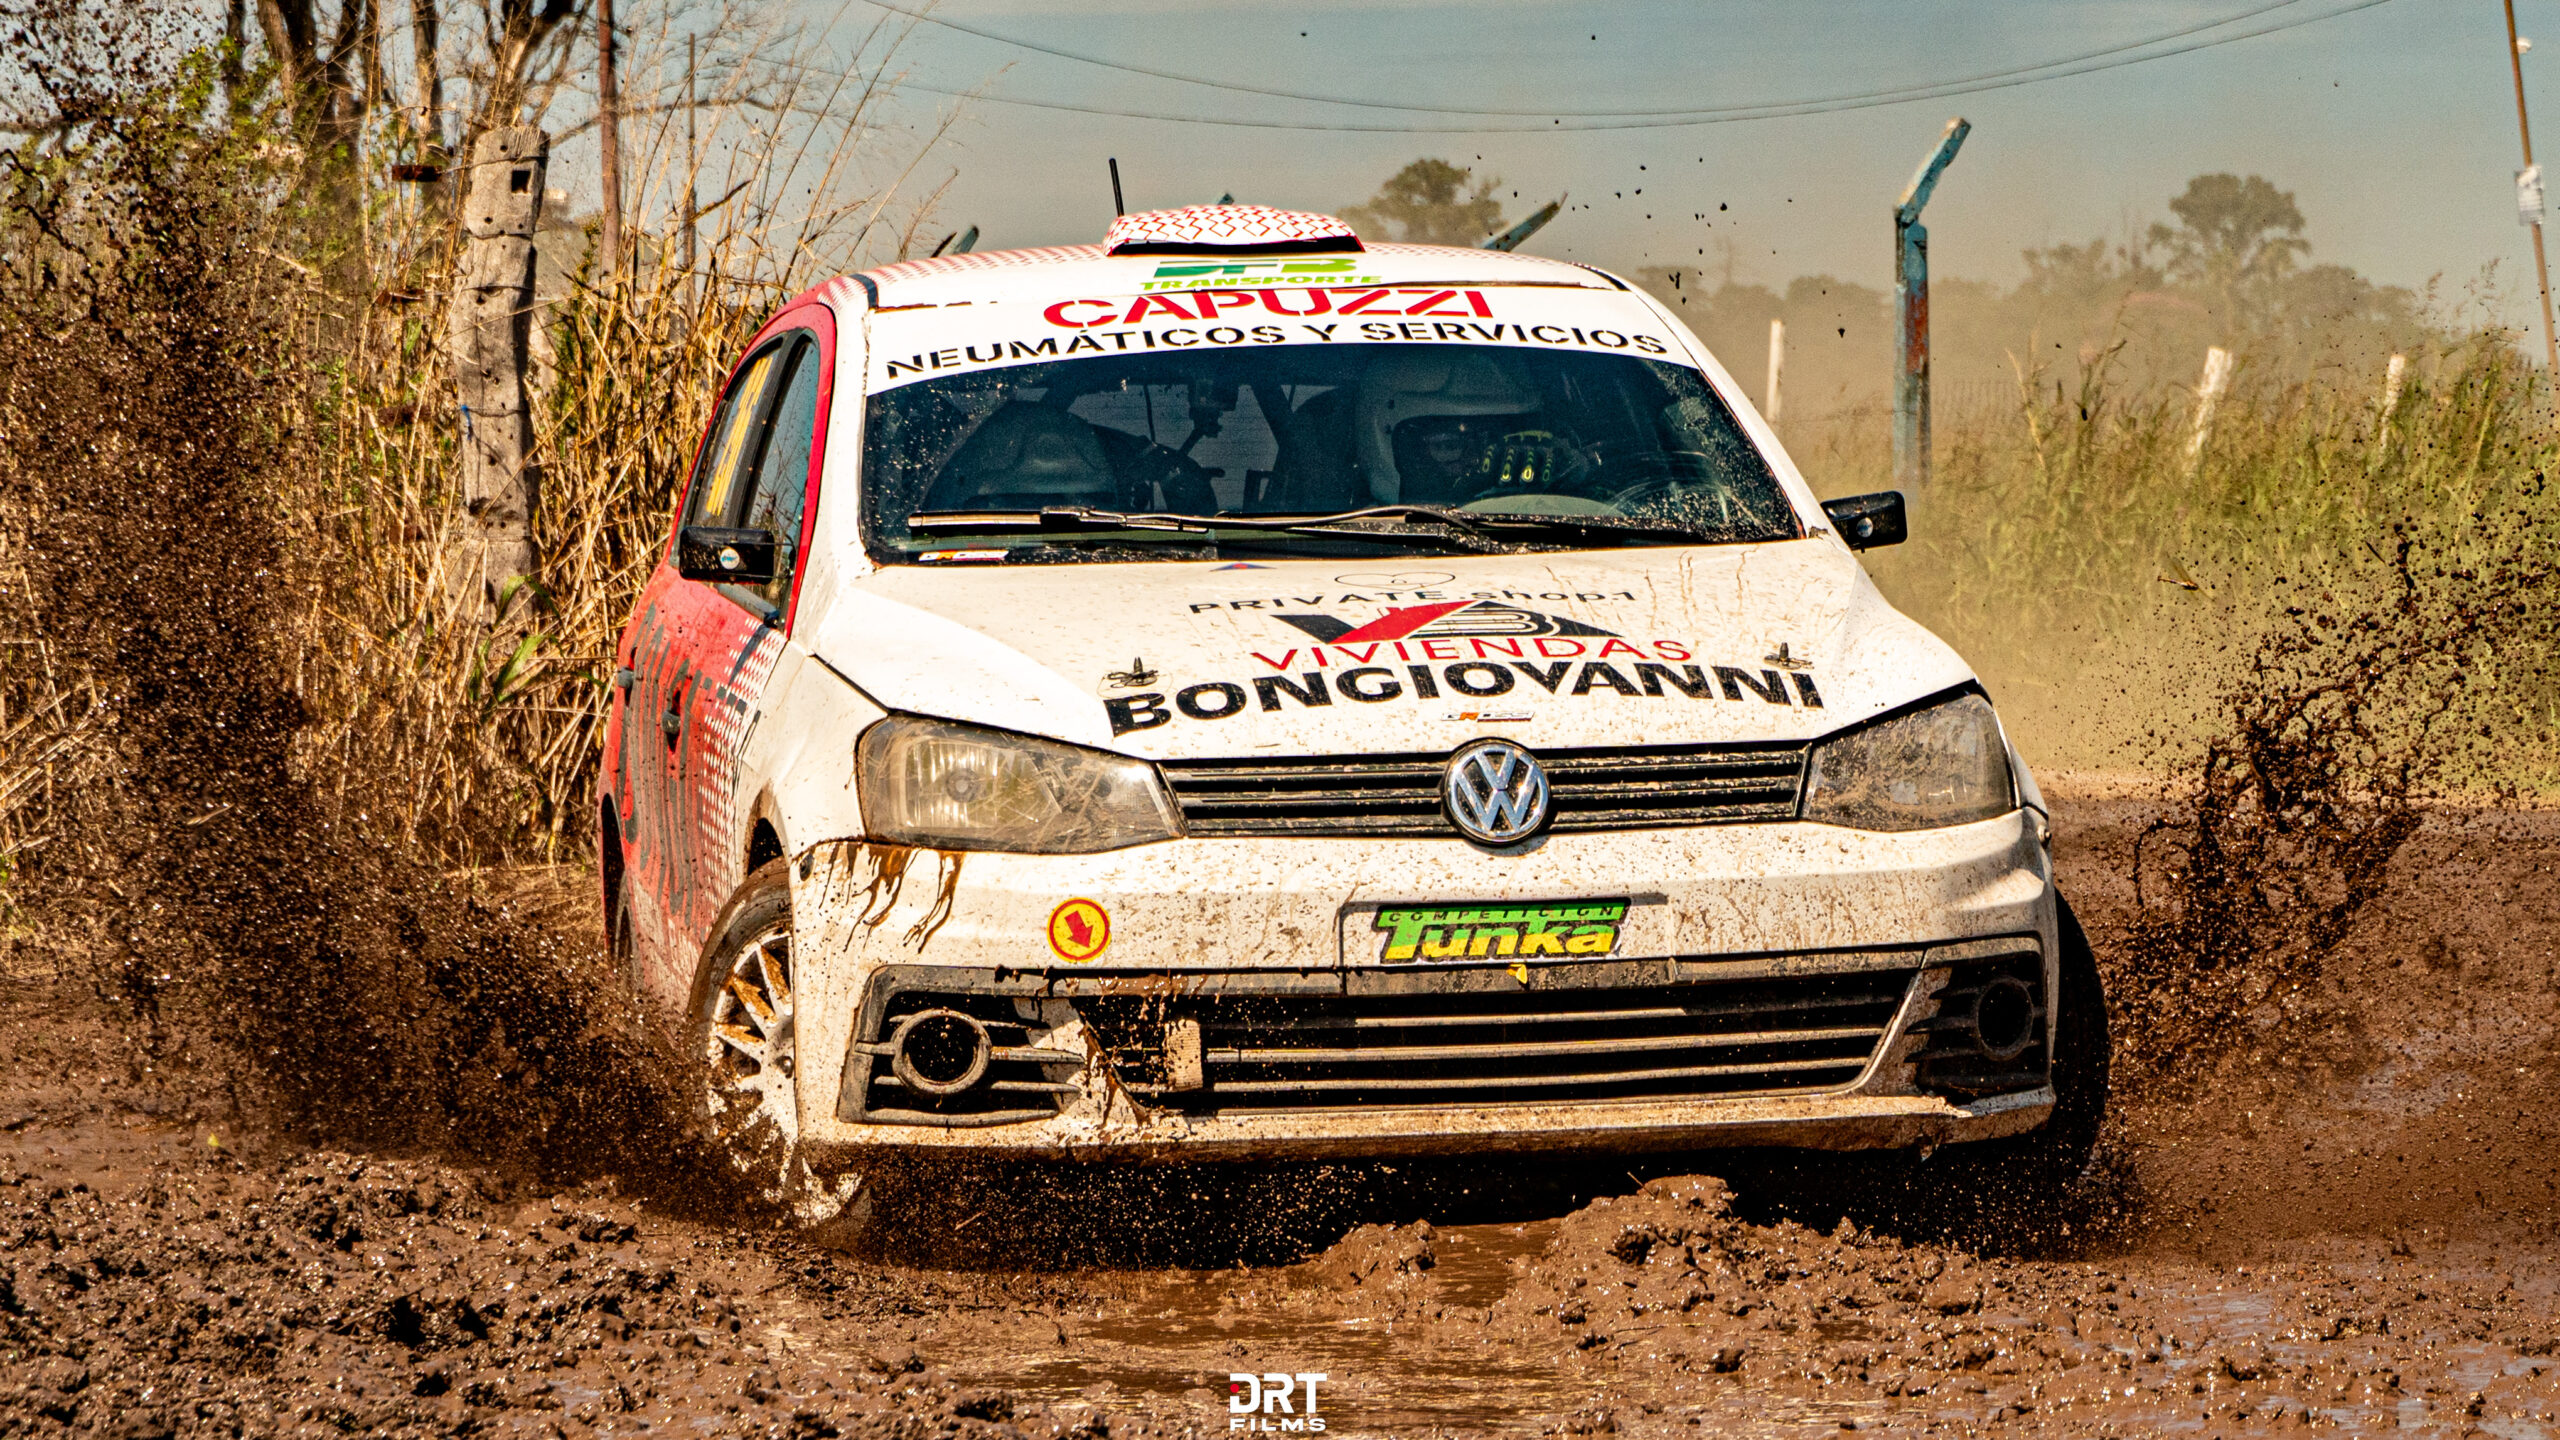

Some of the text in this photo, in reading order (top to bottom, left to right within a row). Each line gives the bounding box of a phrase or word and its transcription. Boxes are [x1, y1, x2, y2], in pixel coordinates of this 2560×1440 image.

[1139, 275, 1382, 290] TRANSPORTE
[1042, 289, 1494, 329] CAPUZZI
[887, 322, 1669, 380] NEUMÁTICOS Y SERVICIOS
[1250, 636, 1692, 671] VIVIENDAS
[1103, 661, 1824, 737] BONGIOVANNI
[1379, 913, 1616, 960] Tunka
